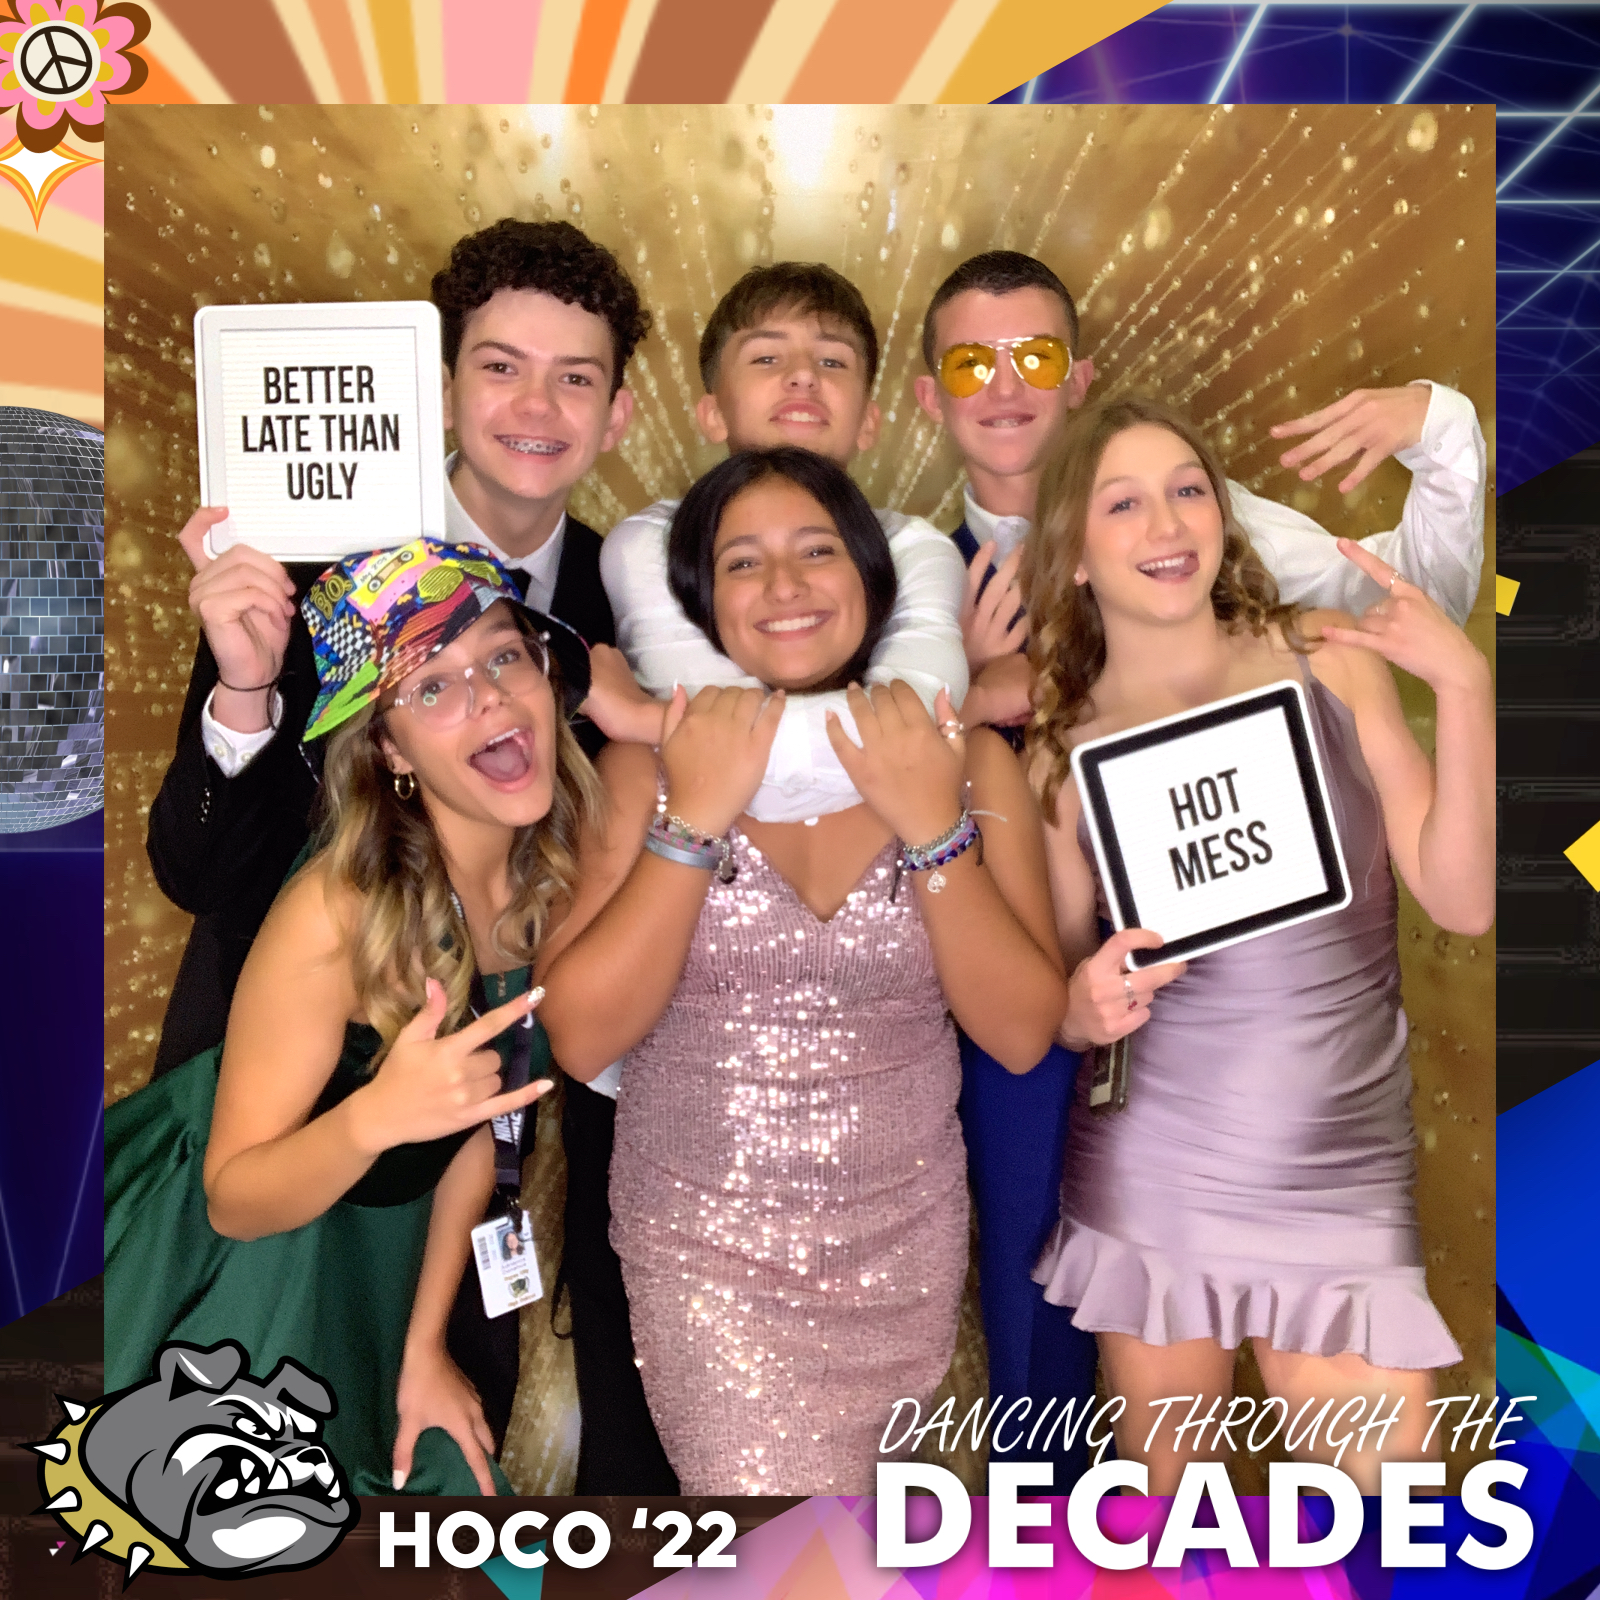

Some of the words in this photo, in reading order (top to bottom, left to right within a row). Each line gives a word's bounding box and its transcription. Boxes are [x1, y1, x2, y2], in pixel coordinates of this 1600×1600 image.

[263, 365, 375, 405] BETTER
[241, 414, 312, 453] LATE
[318, 413, 401, 452] THAN
[286, 462, 358, 500] UGLY
[1167, 766, 1241, 832] HOT
[1167, 819, 1274, 892] MESS
